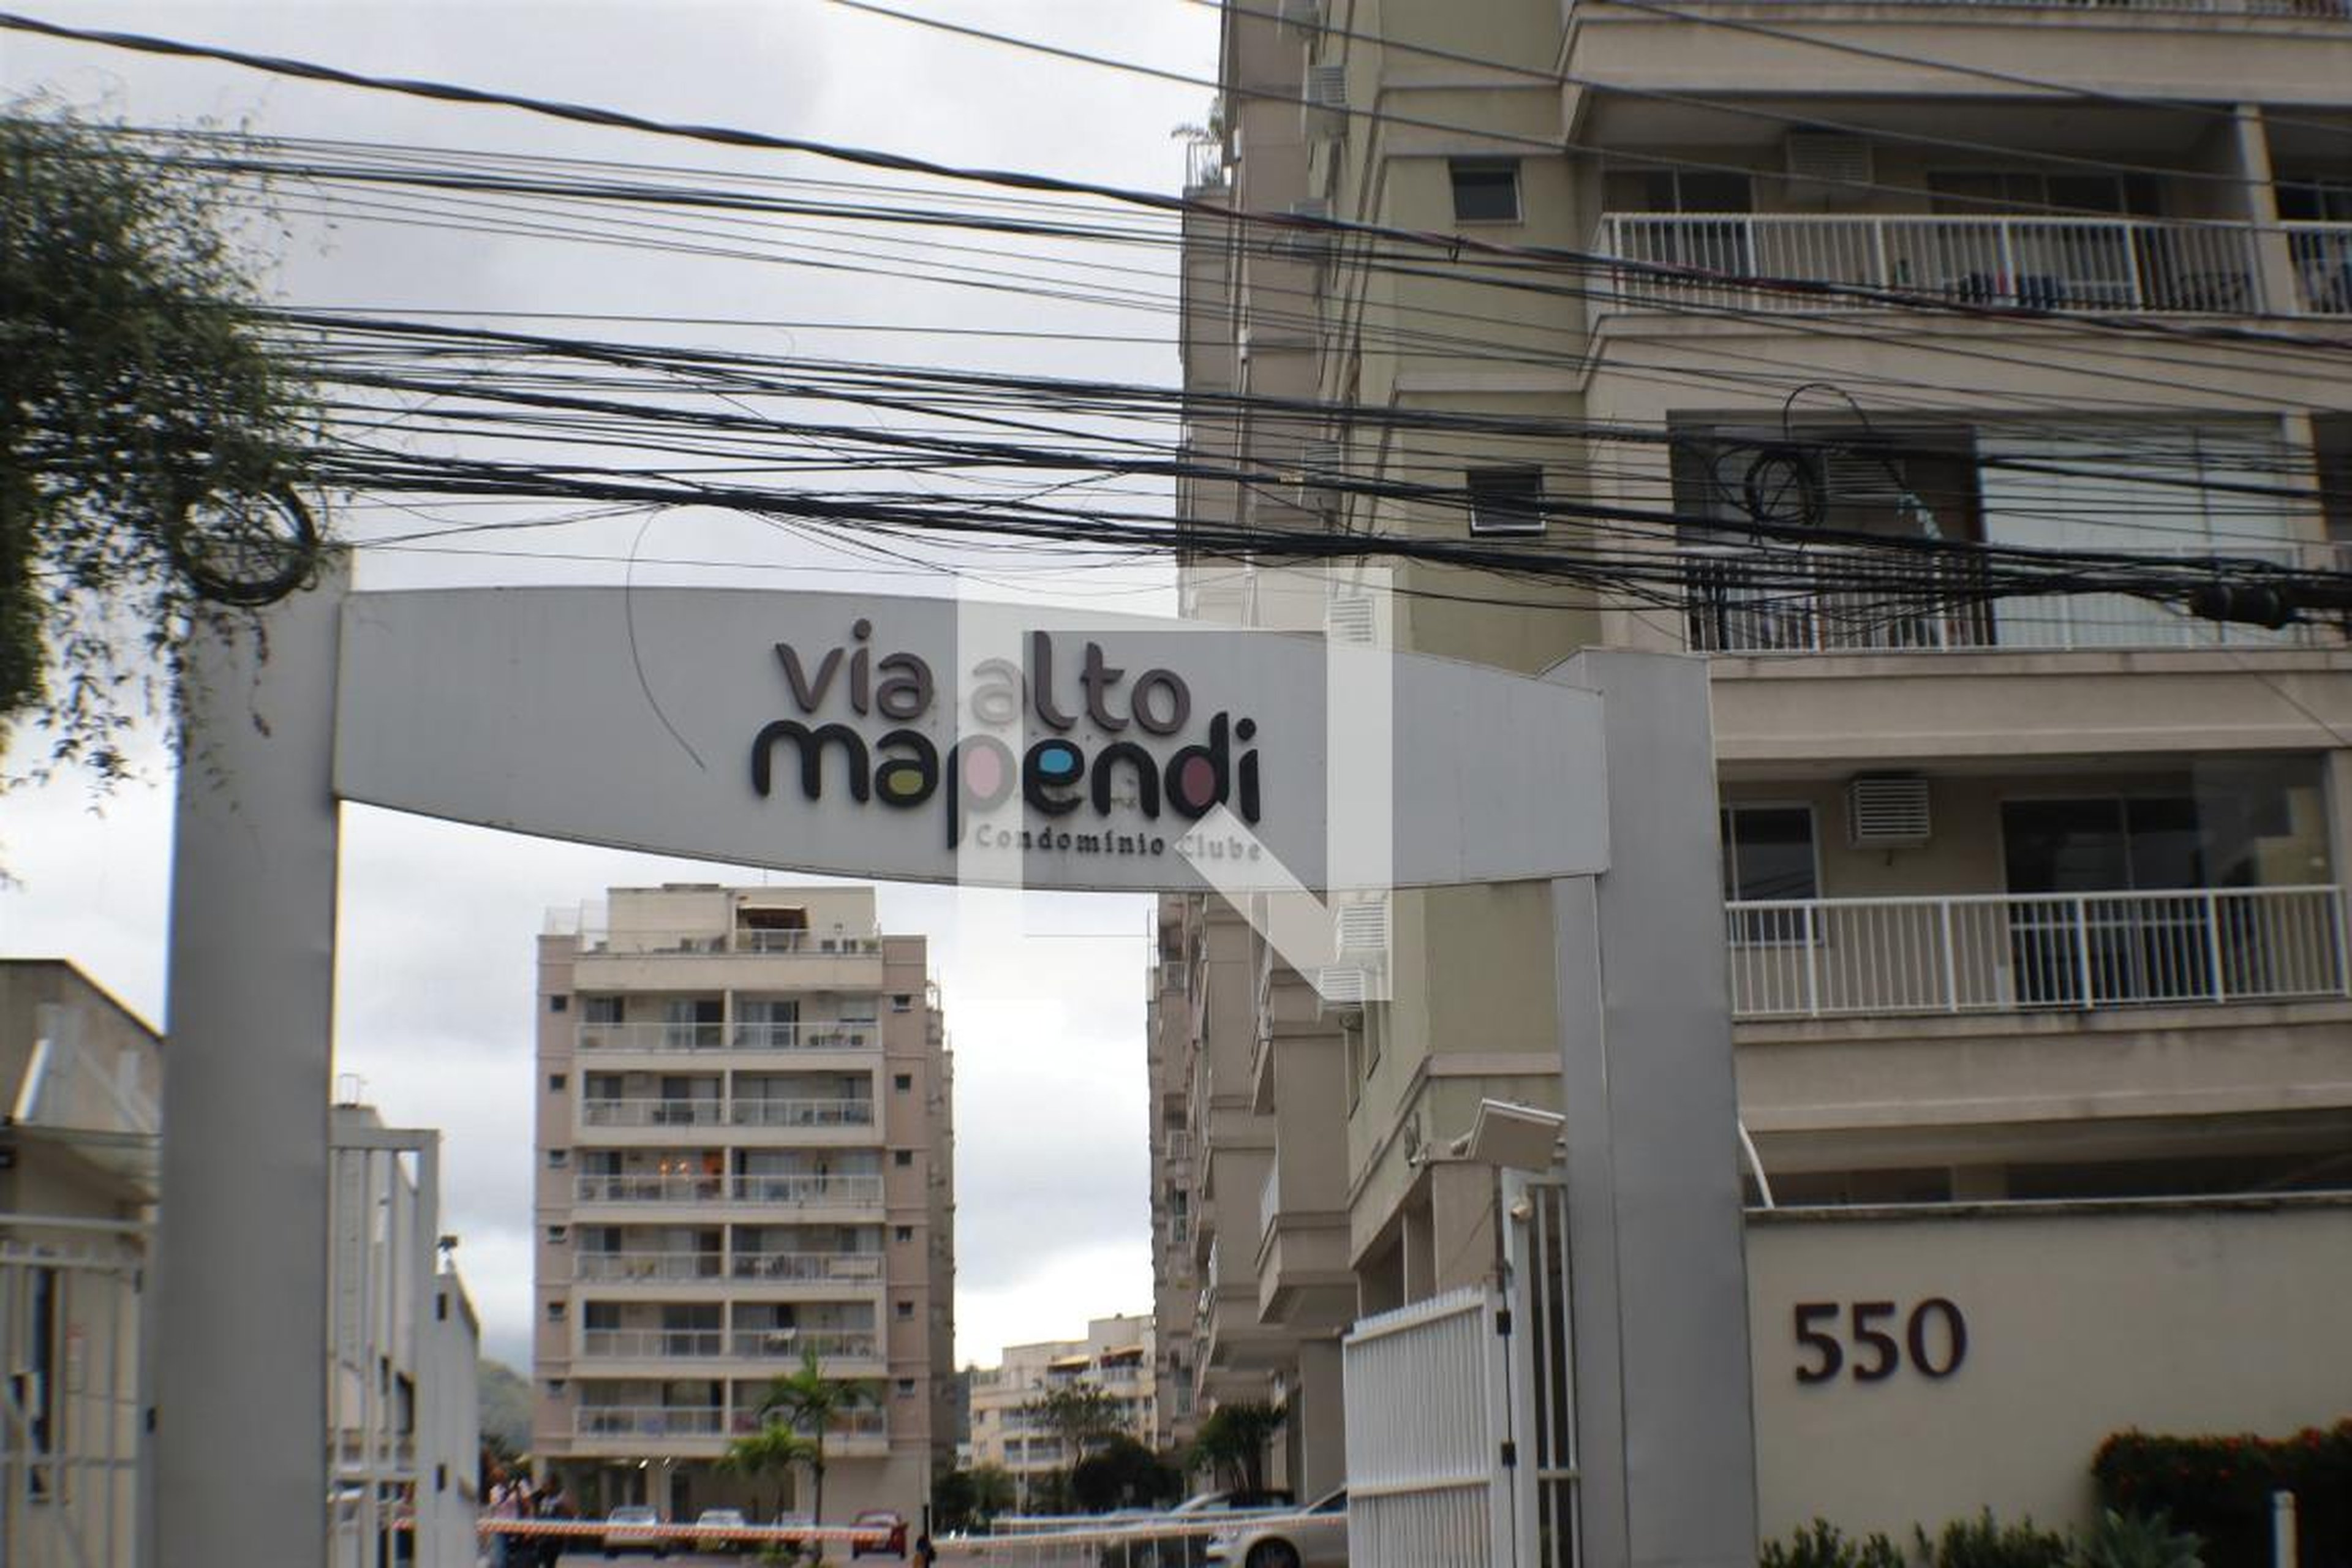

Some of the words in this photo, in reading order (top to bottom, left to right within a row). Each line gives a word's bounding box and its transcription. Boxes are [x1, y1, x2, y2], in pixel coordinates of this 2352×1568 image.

[774, 618, 934, 720] via
[970, 629, 1191, 736] alto
[751, 710, 1261, 850] mapendi
[1178, 833, 1262, 861] Clube
[1795, 1297, 1967, 1384] 550
